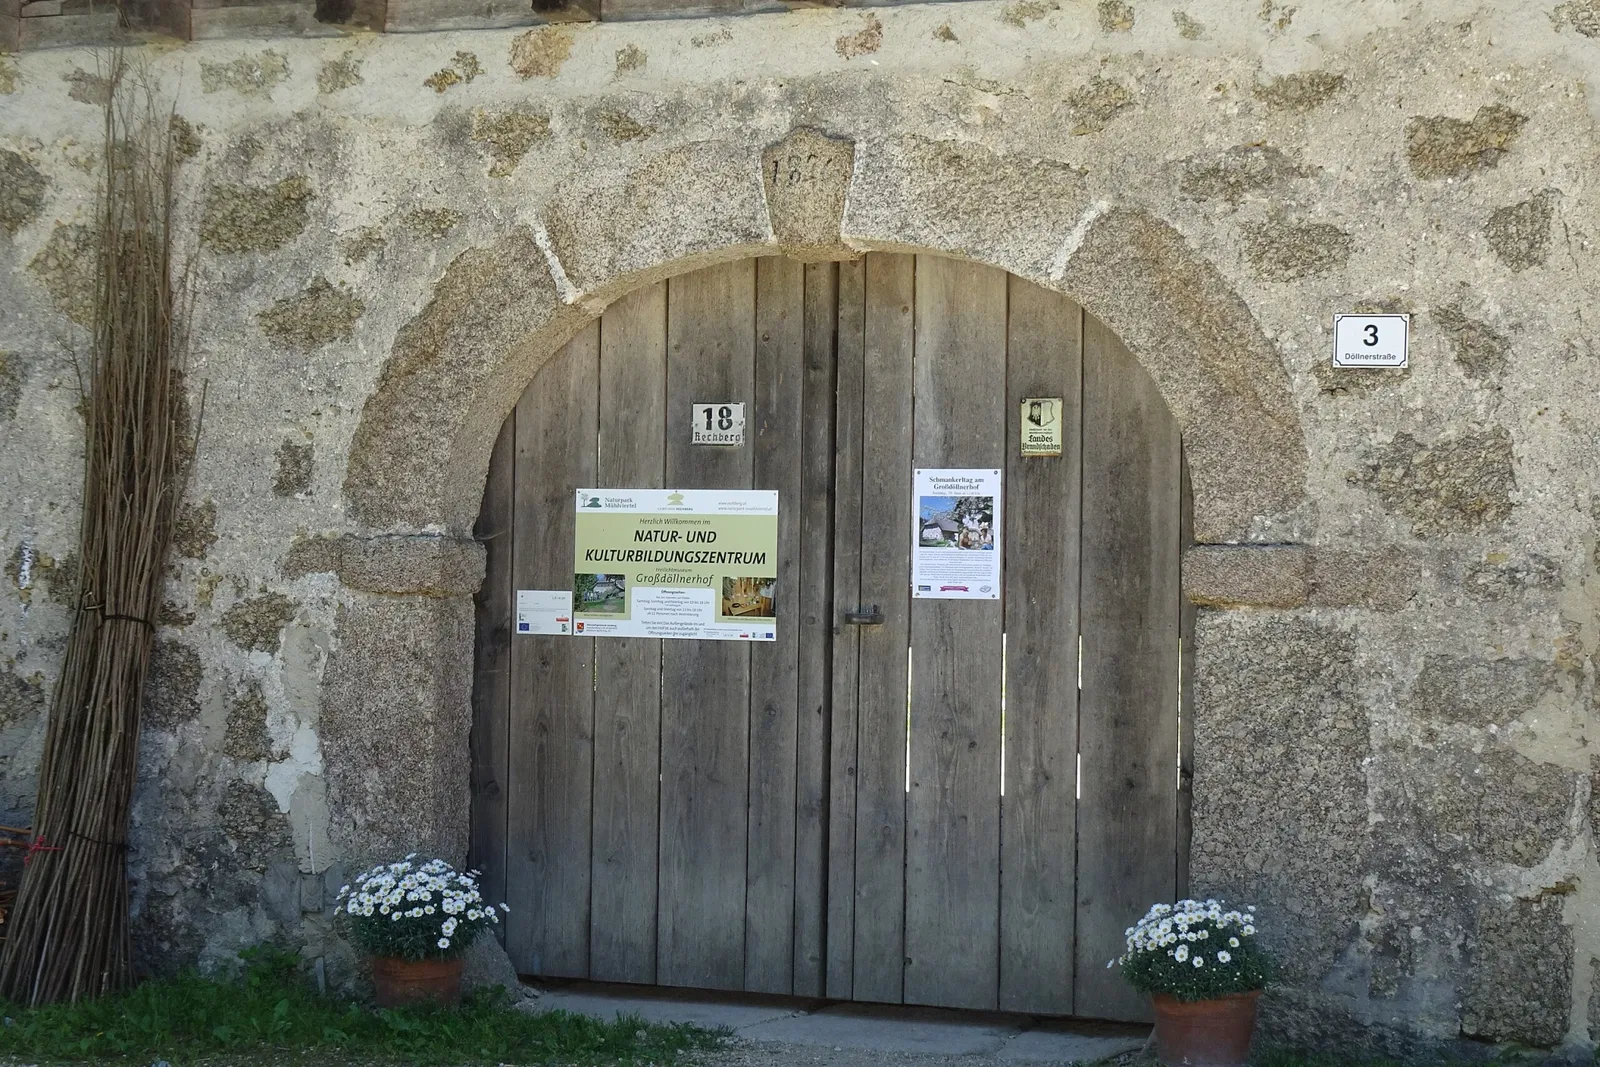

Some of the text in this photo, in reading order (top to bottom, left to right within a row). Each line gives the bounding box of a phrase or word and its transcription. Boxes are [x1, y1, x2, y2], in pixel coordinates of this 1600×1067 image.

[1363, 324, 1379, 346] 3
[1344, 352, 1397, 360] Döllnerstraße
[702, 406, 733, 431] 18
[694, 431, 741, 443] Rechberg
[1028, 434, 1054, 443] Landes
[928, 476, 973, 484] Schmankerltag
[633, 529, 717, 544] NATUR- UND
[585, 549, 766, 565] KULTURBILDUNGSZENTRUM
[636, 573, 714, 586] Großdöllnerhof
